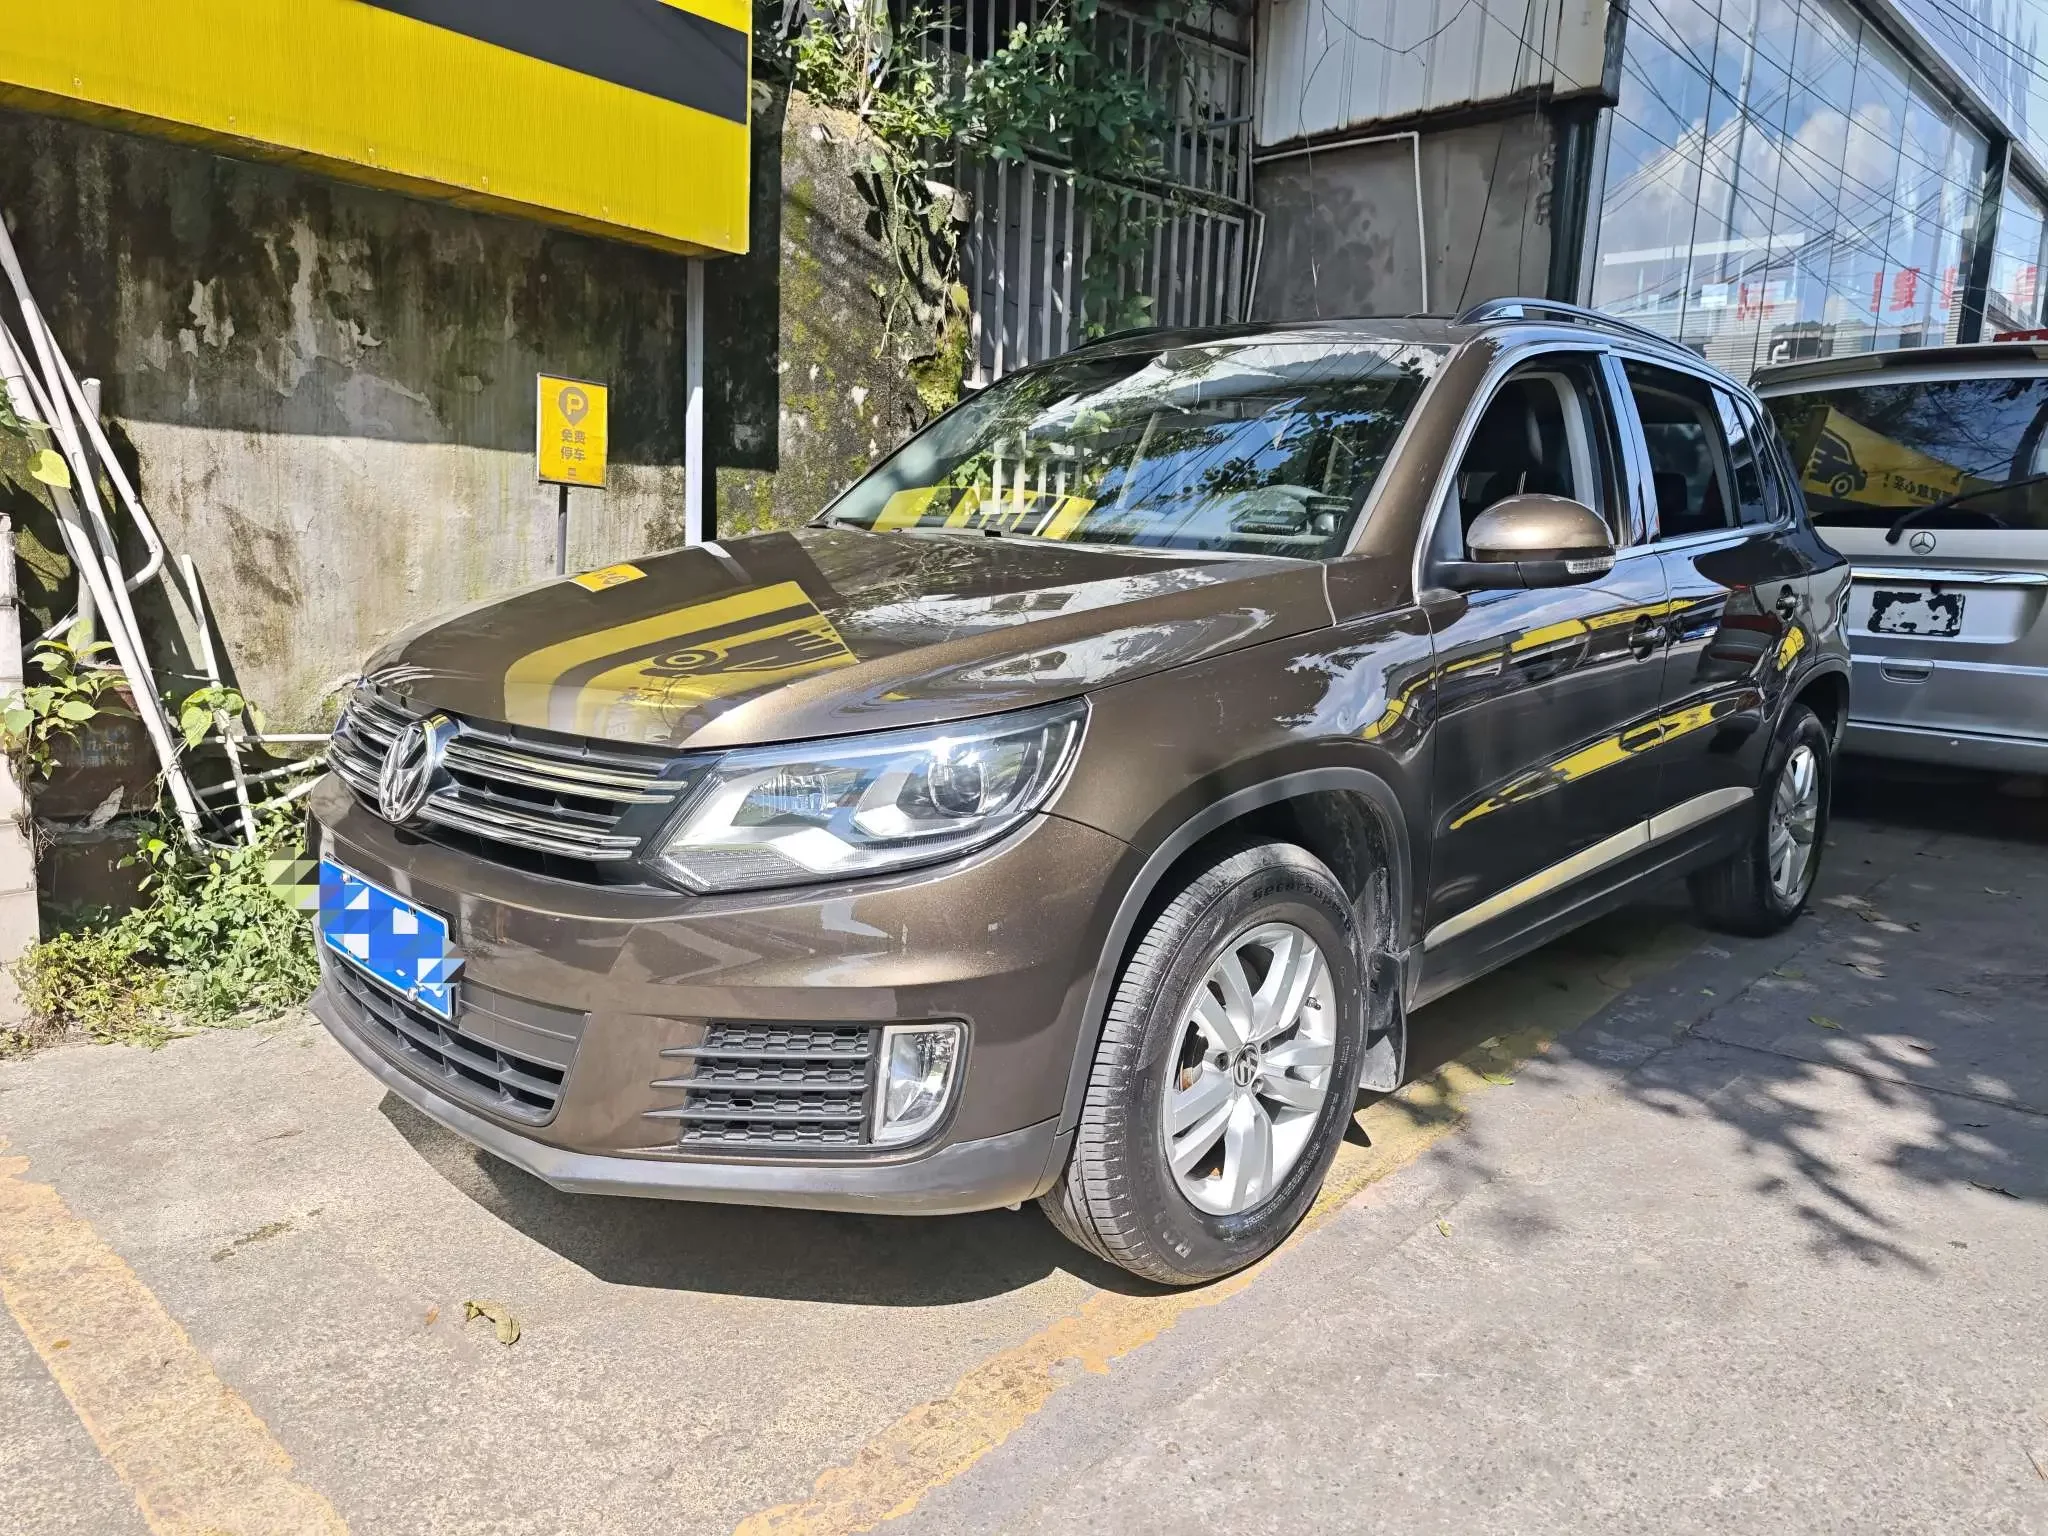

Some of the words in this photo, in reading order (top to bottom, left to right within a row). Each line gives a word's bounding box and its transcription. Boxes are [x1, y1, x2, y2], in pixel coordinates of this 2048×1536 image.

[566, 394, 584, 415] P
[561, 428, 586, 445] 免费
[561, 447, 586, 461] 停车
